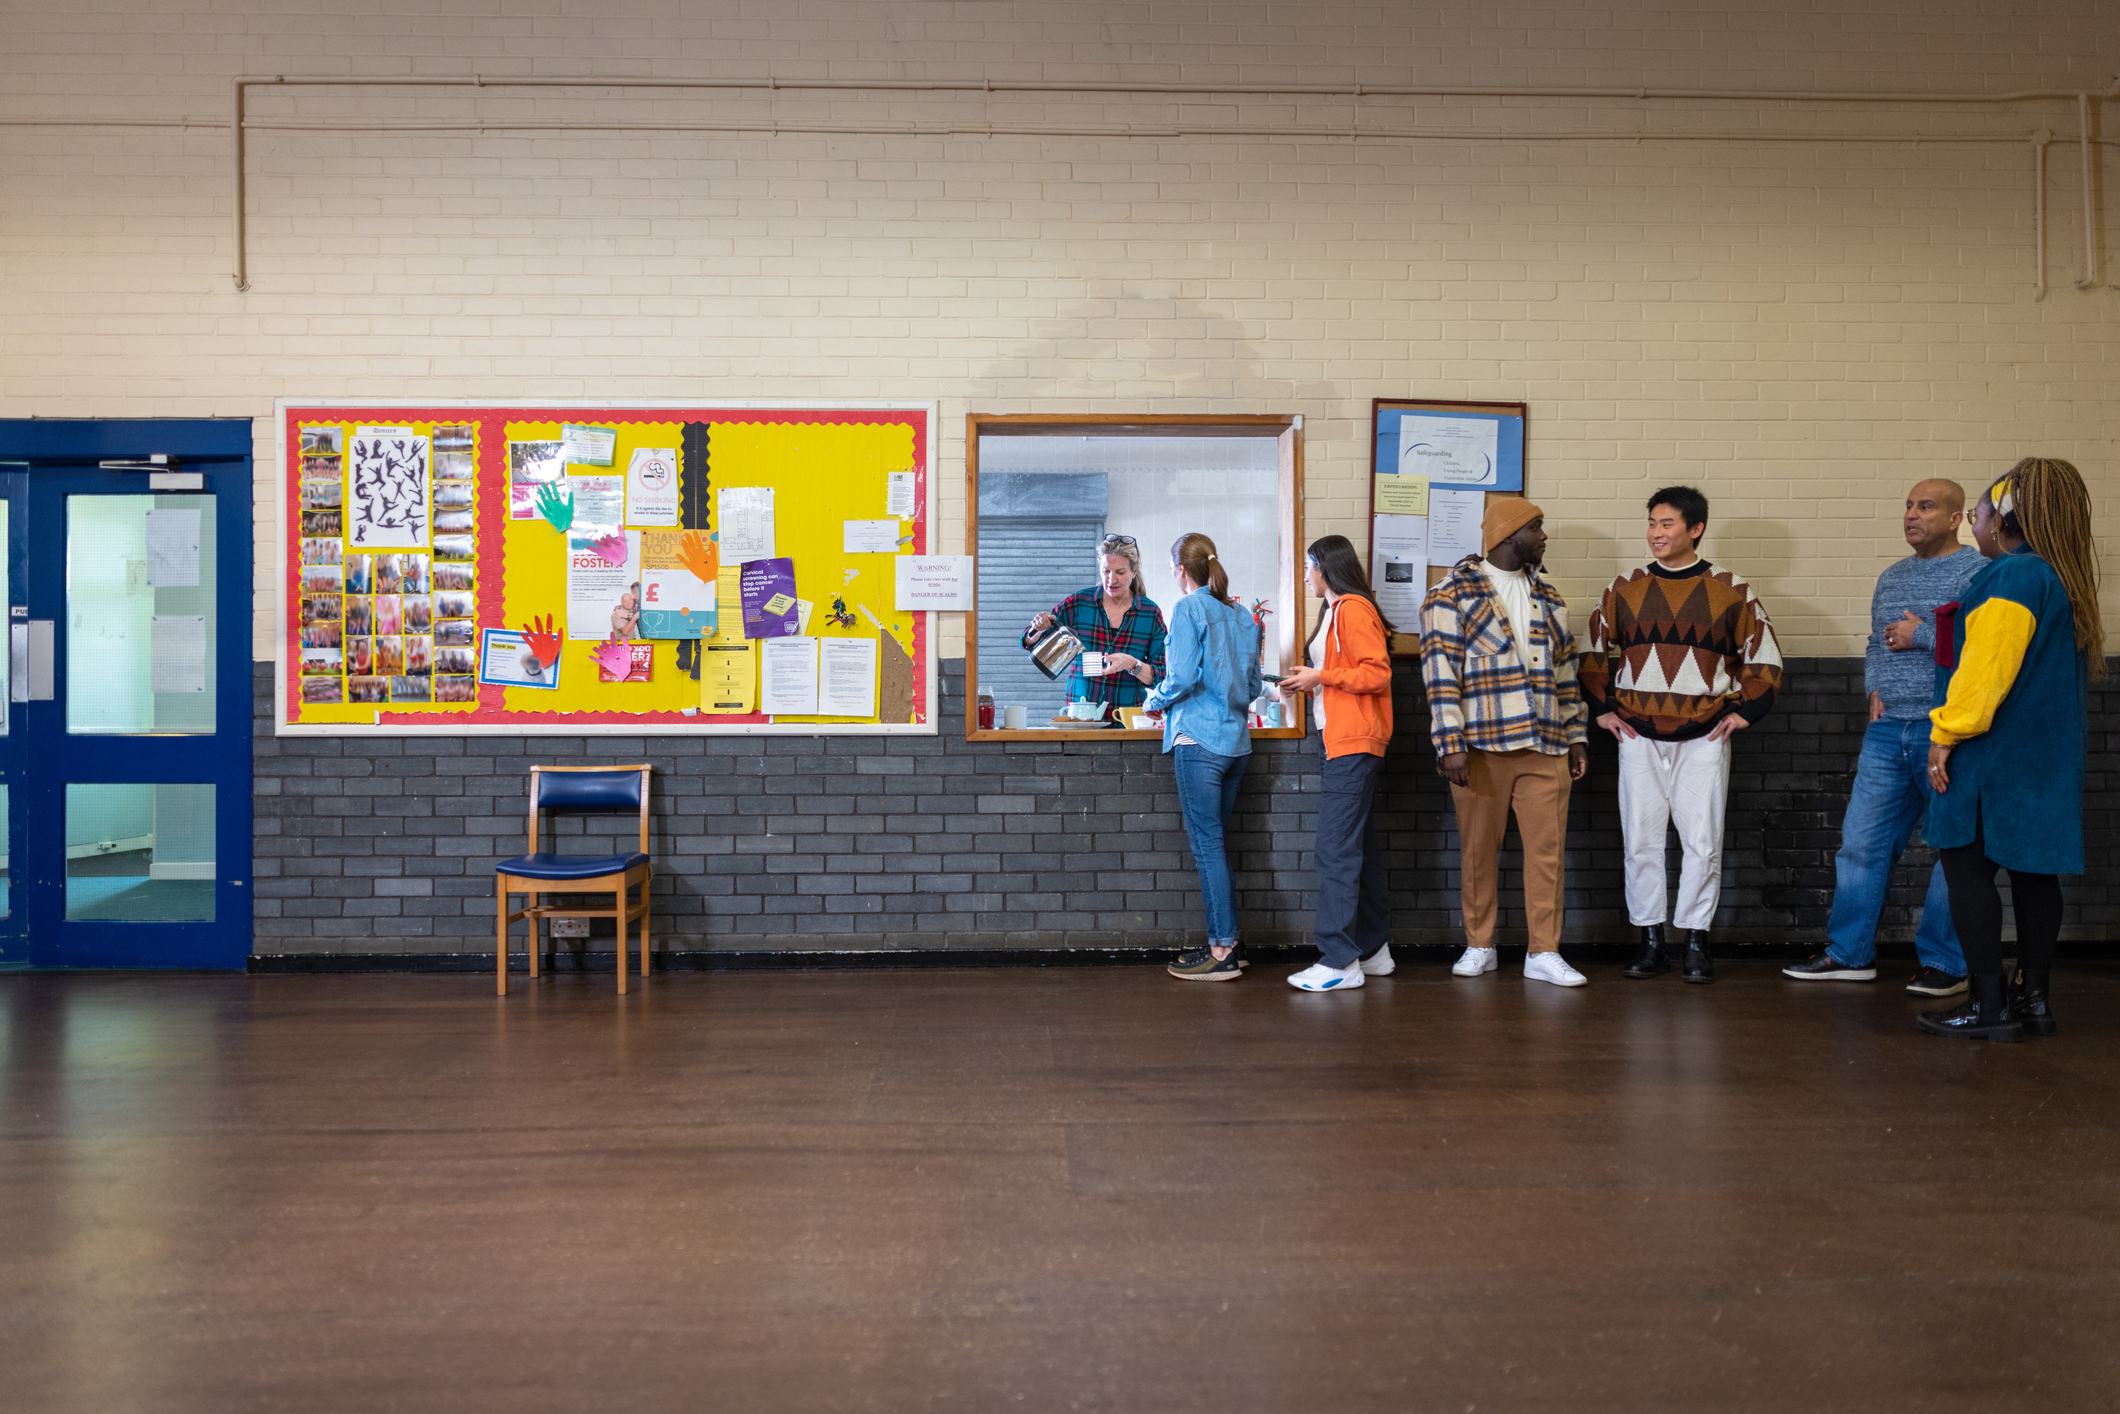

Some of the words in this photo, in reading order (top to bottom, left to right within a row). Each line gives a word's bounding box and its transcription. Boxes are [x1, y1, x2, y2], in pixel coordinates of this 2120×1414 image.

[1416, 449, 1453, 458] Safeguarding
[645, 543, 672, 555] YOU
[646, 583, 660, 602] £
